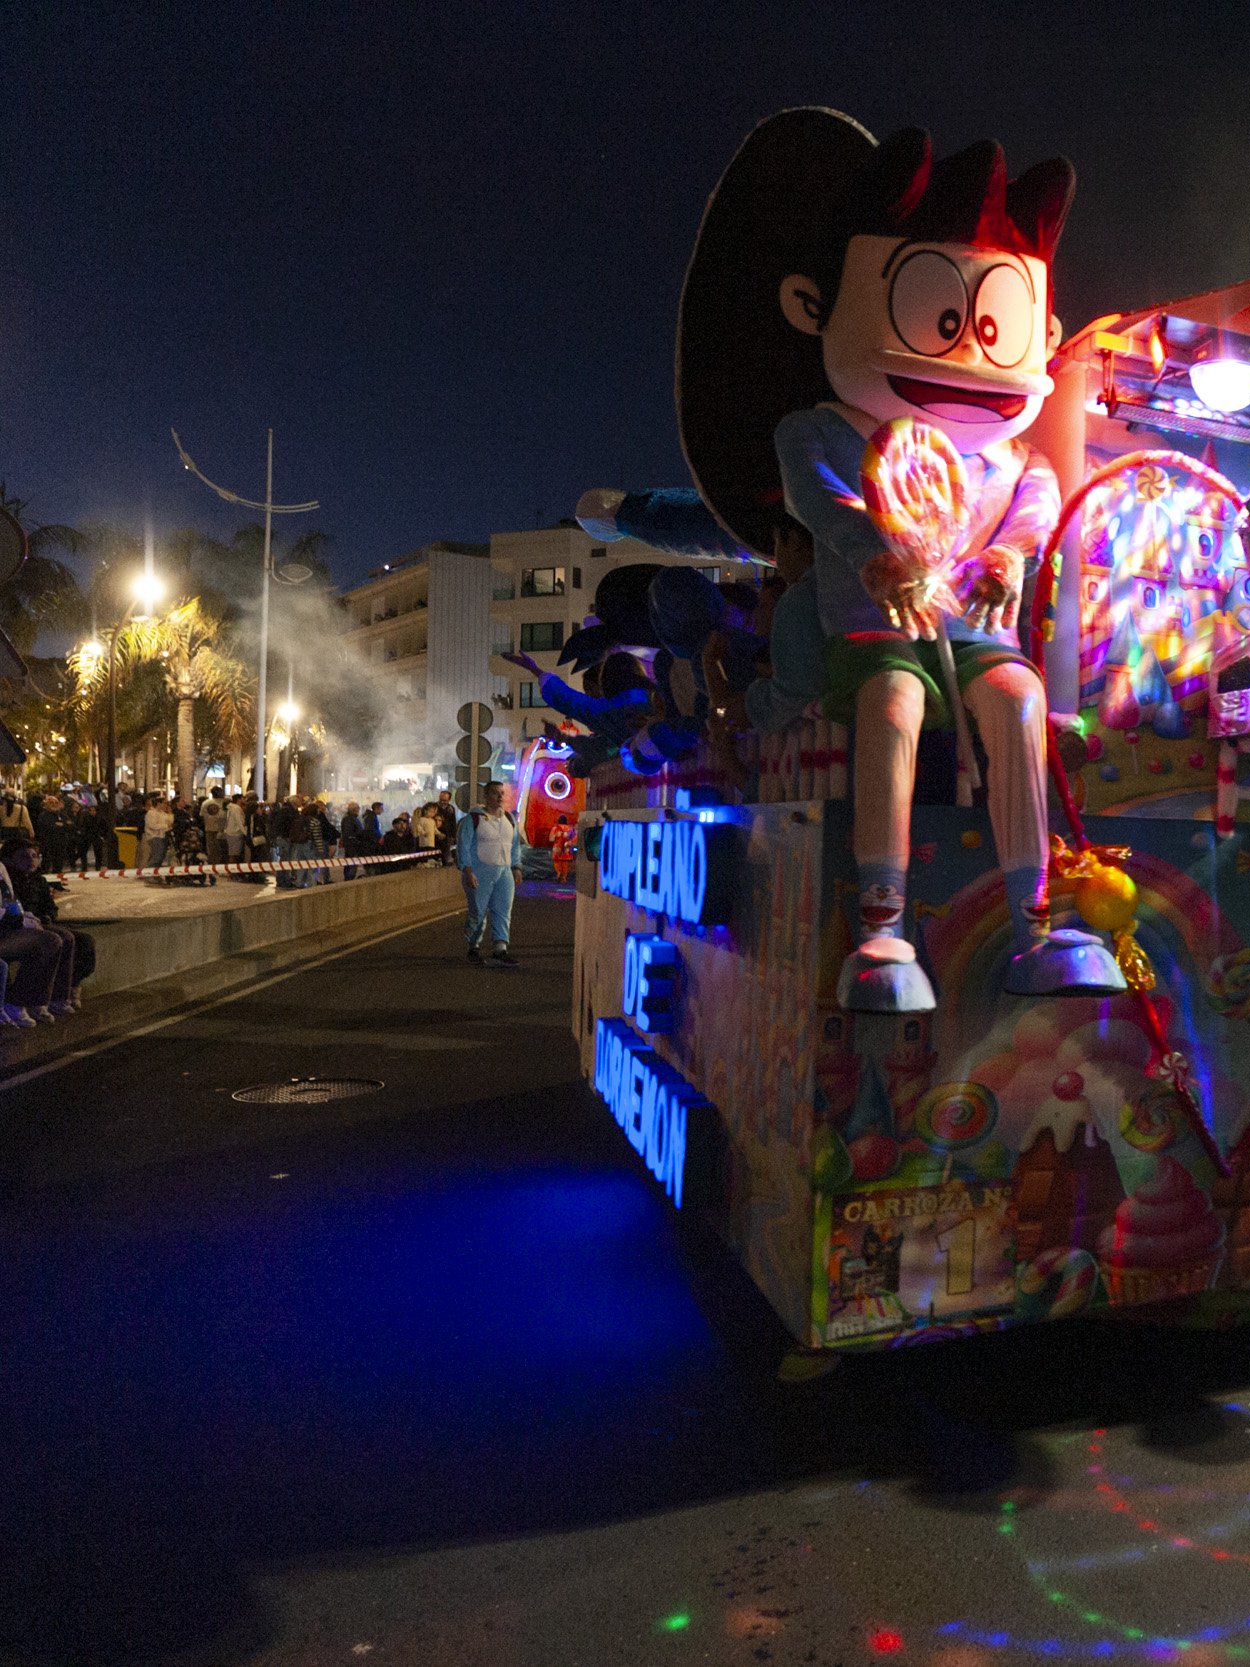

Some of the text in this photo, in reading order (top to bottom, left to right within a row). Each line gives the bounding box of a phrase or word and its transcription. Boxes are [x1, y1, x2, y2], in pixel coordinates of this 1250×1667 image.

[595, 1017, 688, 1210] DORAEMON
[843, 1191, 974, 1223] CARROZA
[935, 1217, 976, 1296] 1
